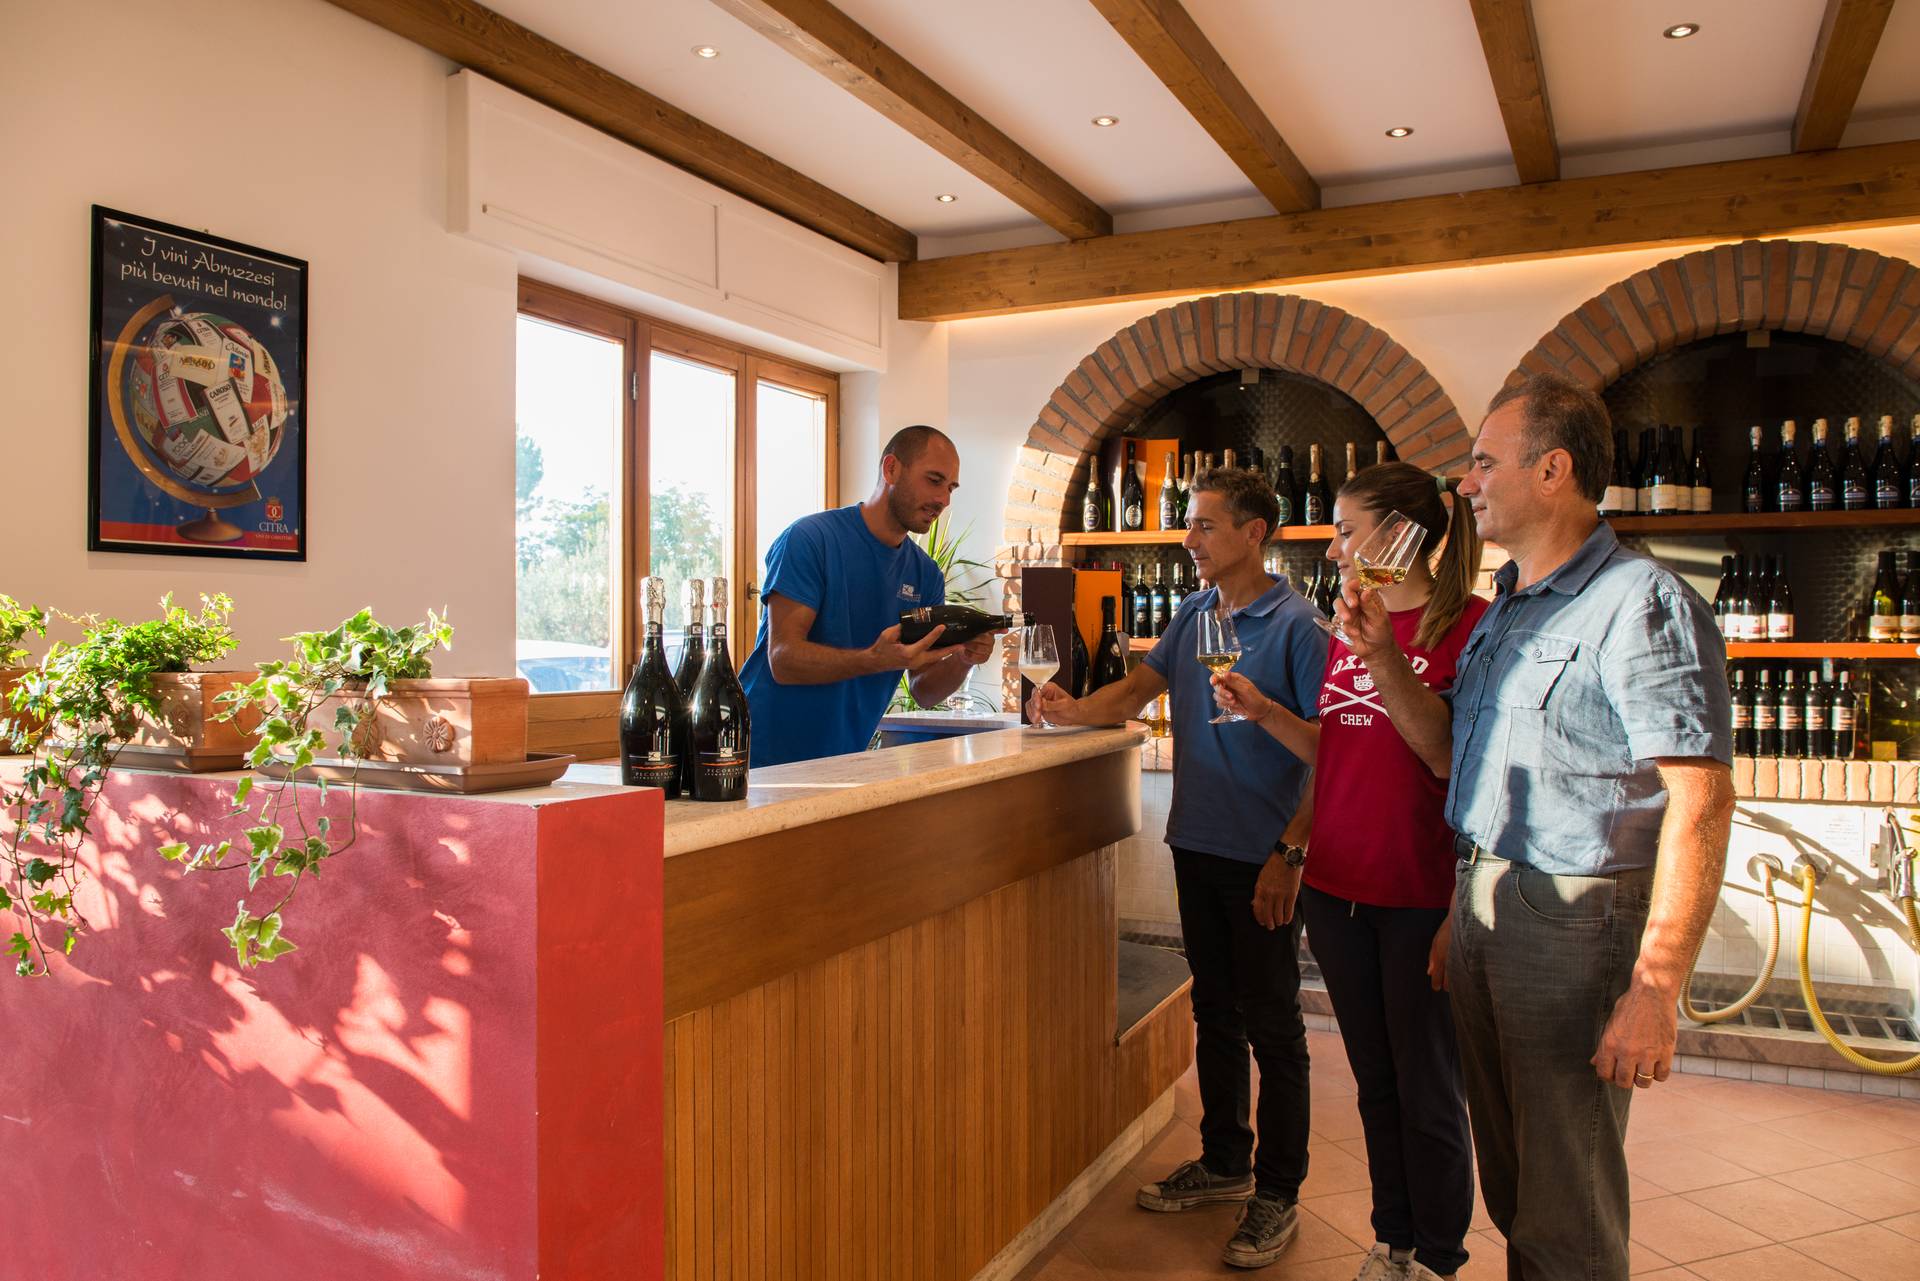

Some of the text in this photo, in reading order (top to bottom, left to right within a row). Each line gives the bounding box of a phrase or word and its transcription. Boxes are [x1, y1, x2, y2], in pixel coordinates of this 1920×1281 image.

[160, 246, 188, 265] vini
[191, 251, 275, 287] Abruzzesi
[121, 261, 287, 311] più bevuti nel mondo!
[258, 521, 289, 534] CITRA
[1340, 713, 1374, 726] CREW
